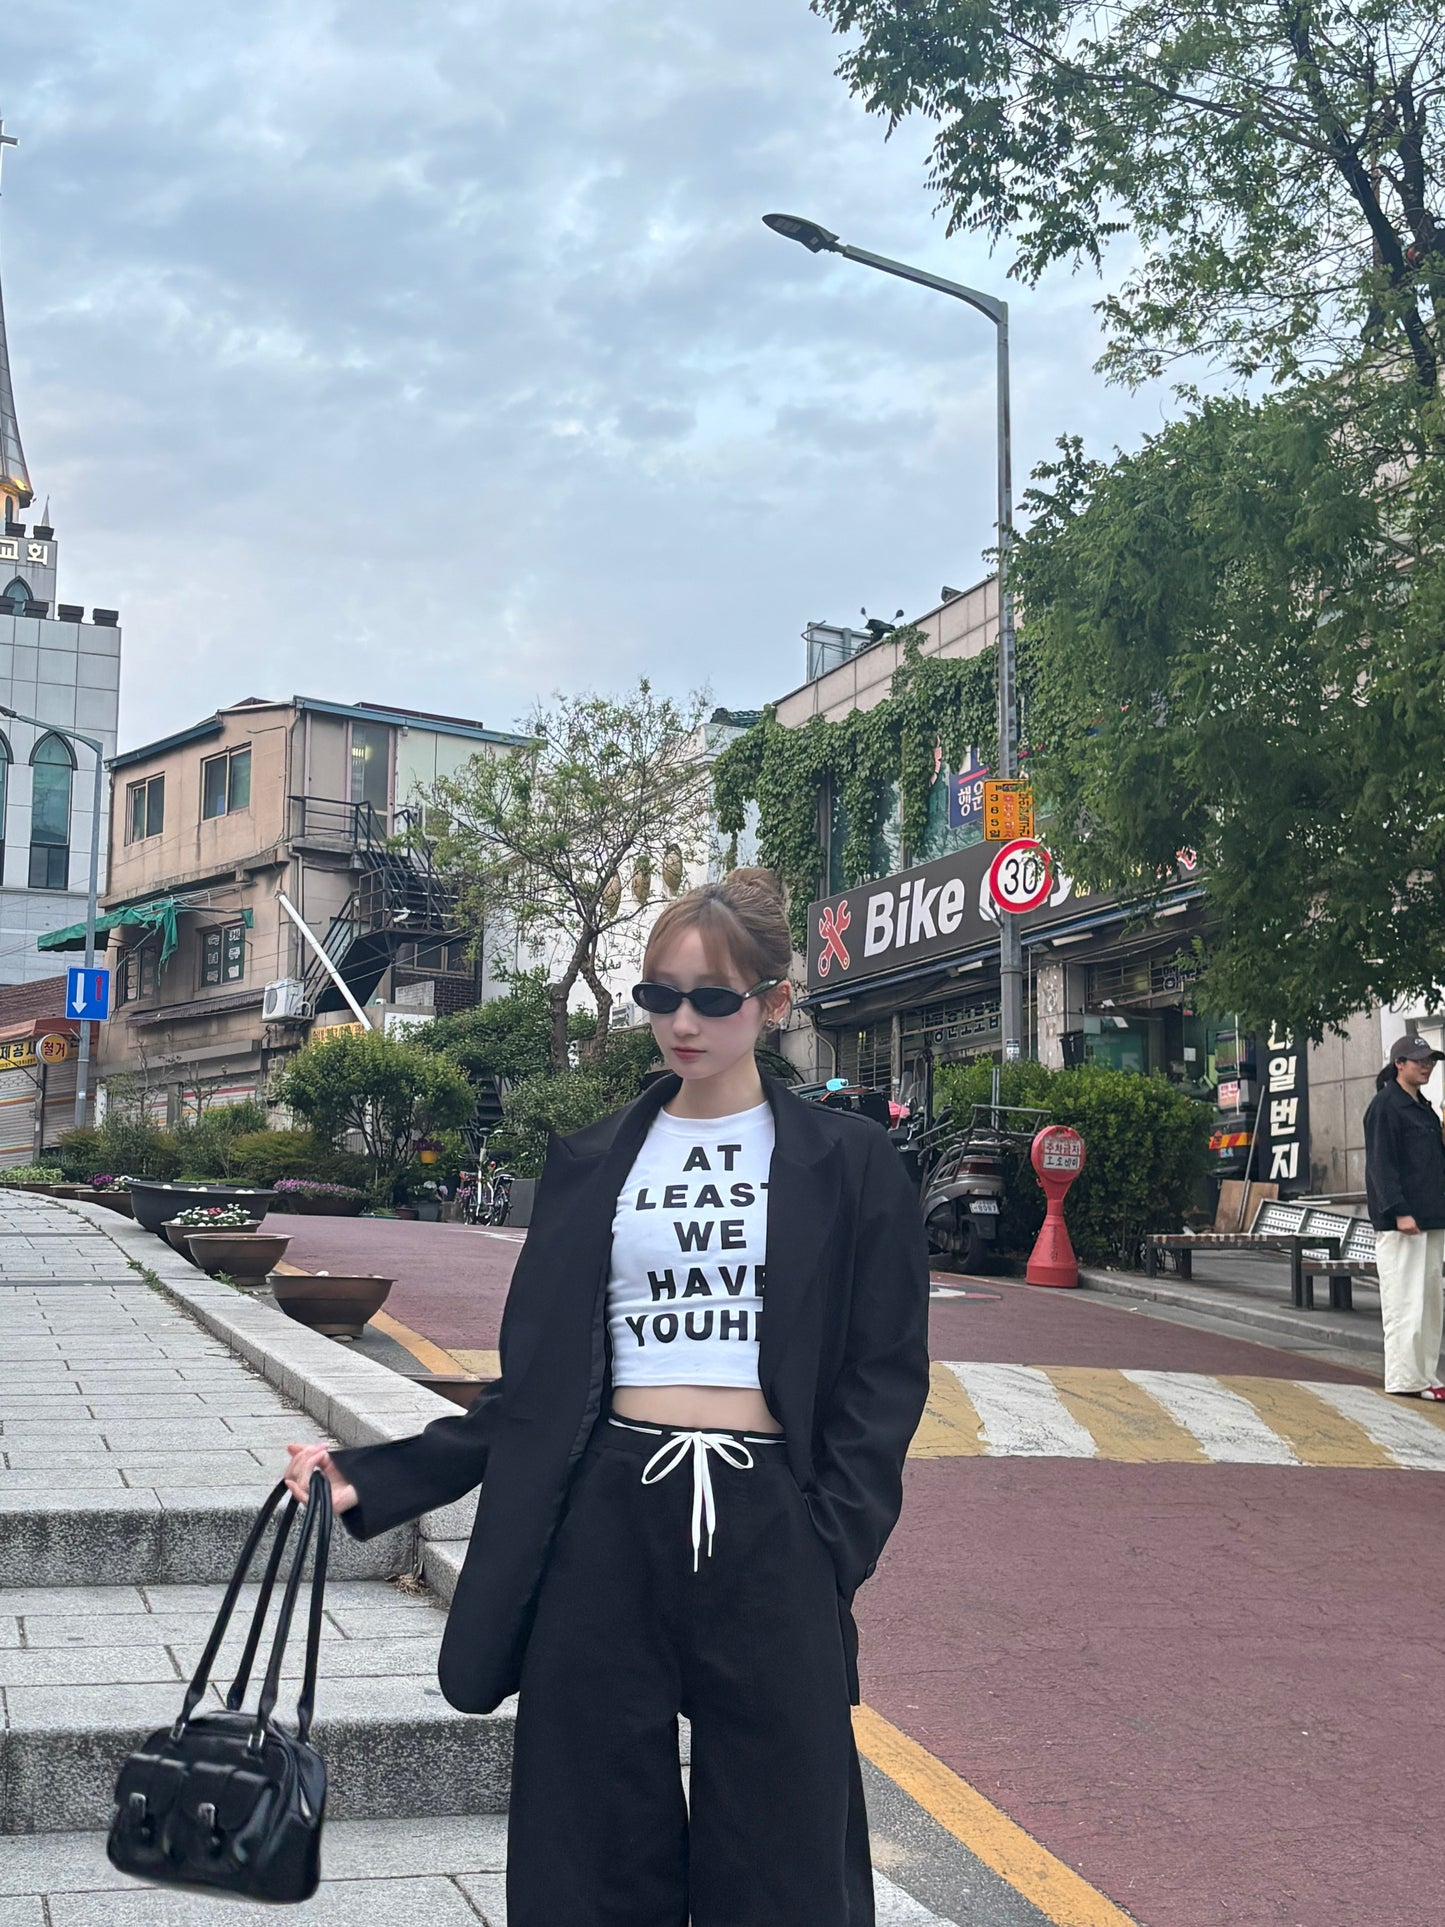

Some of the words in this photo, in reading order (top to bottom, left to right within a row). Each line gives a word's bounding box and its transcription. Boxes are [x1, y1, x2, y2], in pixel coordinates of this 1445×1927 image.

[1004, 858, 1037, 895] 30
[864, 878, 965, 957] Bike
[44, 1041, 66, 1058] 철거
[683, 1144, 742, 1171] AT
[673, 1219, 747, 1252] WE
[625, 1309, 760, 1347] YOUH
